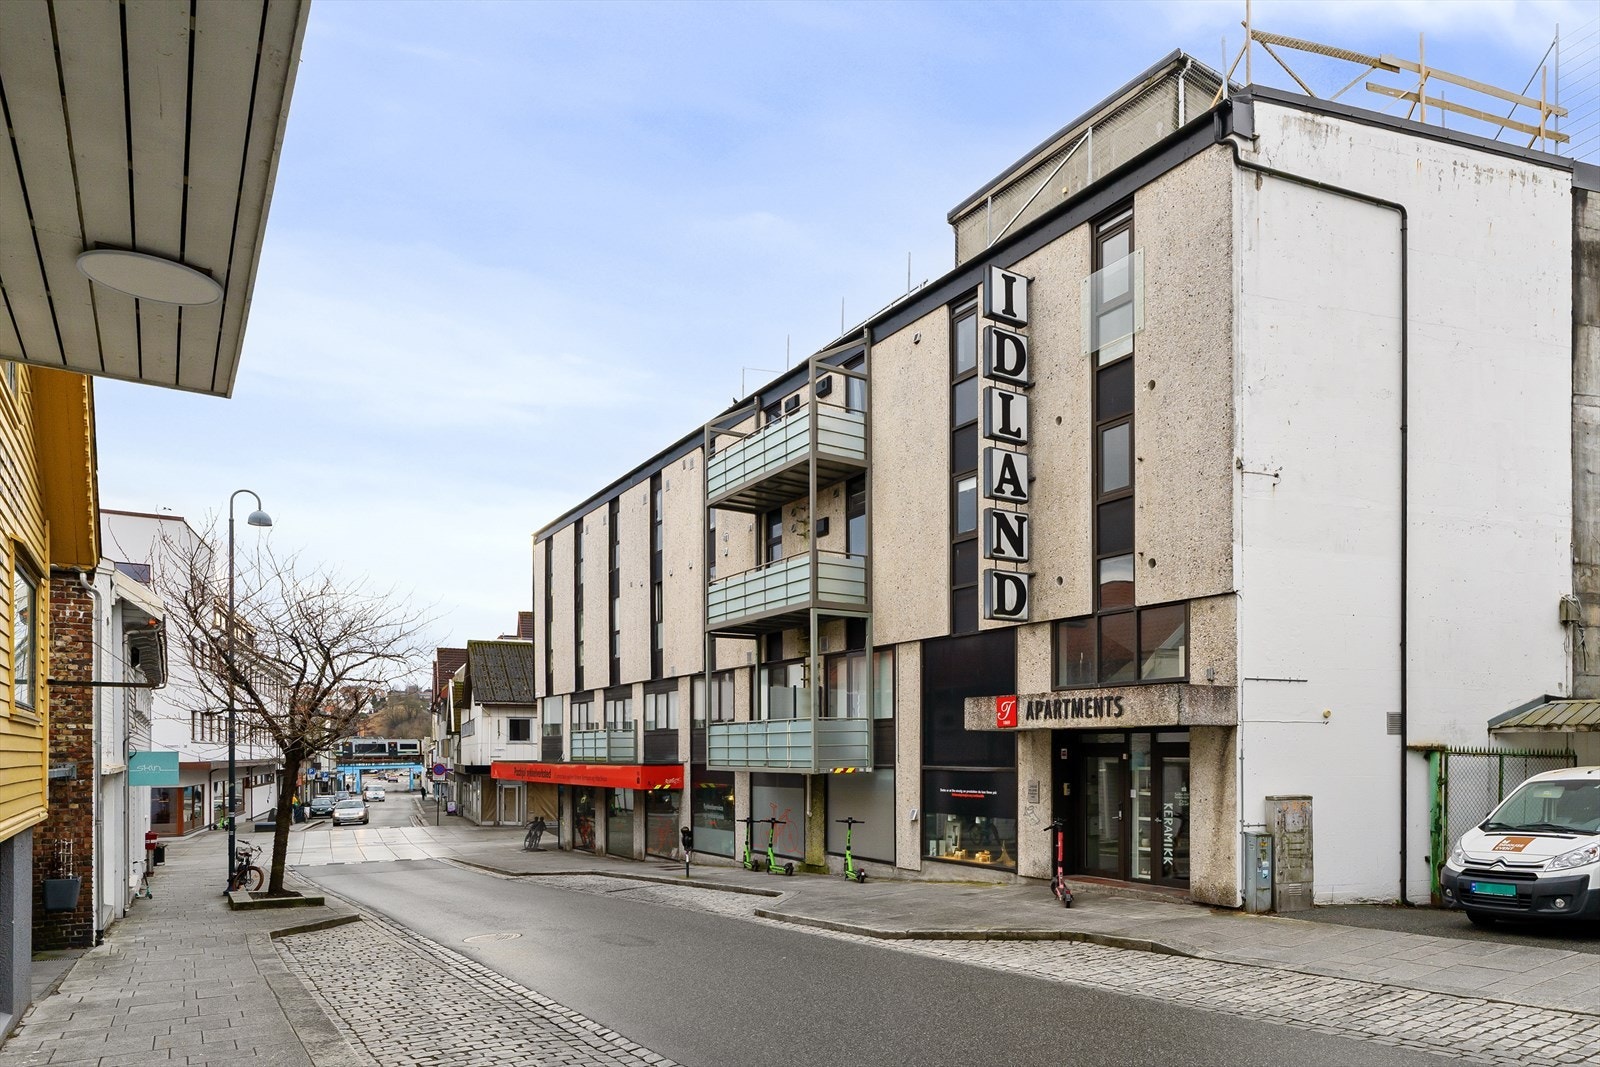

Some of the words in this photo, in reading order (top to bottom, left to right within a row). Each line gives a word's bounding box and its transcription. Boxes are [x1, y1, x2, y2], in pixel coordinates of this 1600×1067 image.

[993, 273, 1027, 617] IDLAND
[1026, 697, 1124, 720] APARTMENTS
[1164, 803, 1173, 865] KERAMIKK
